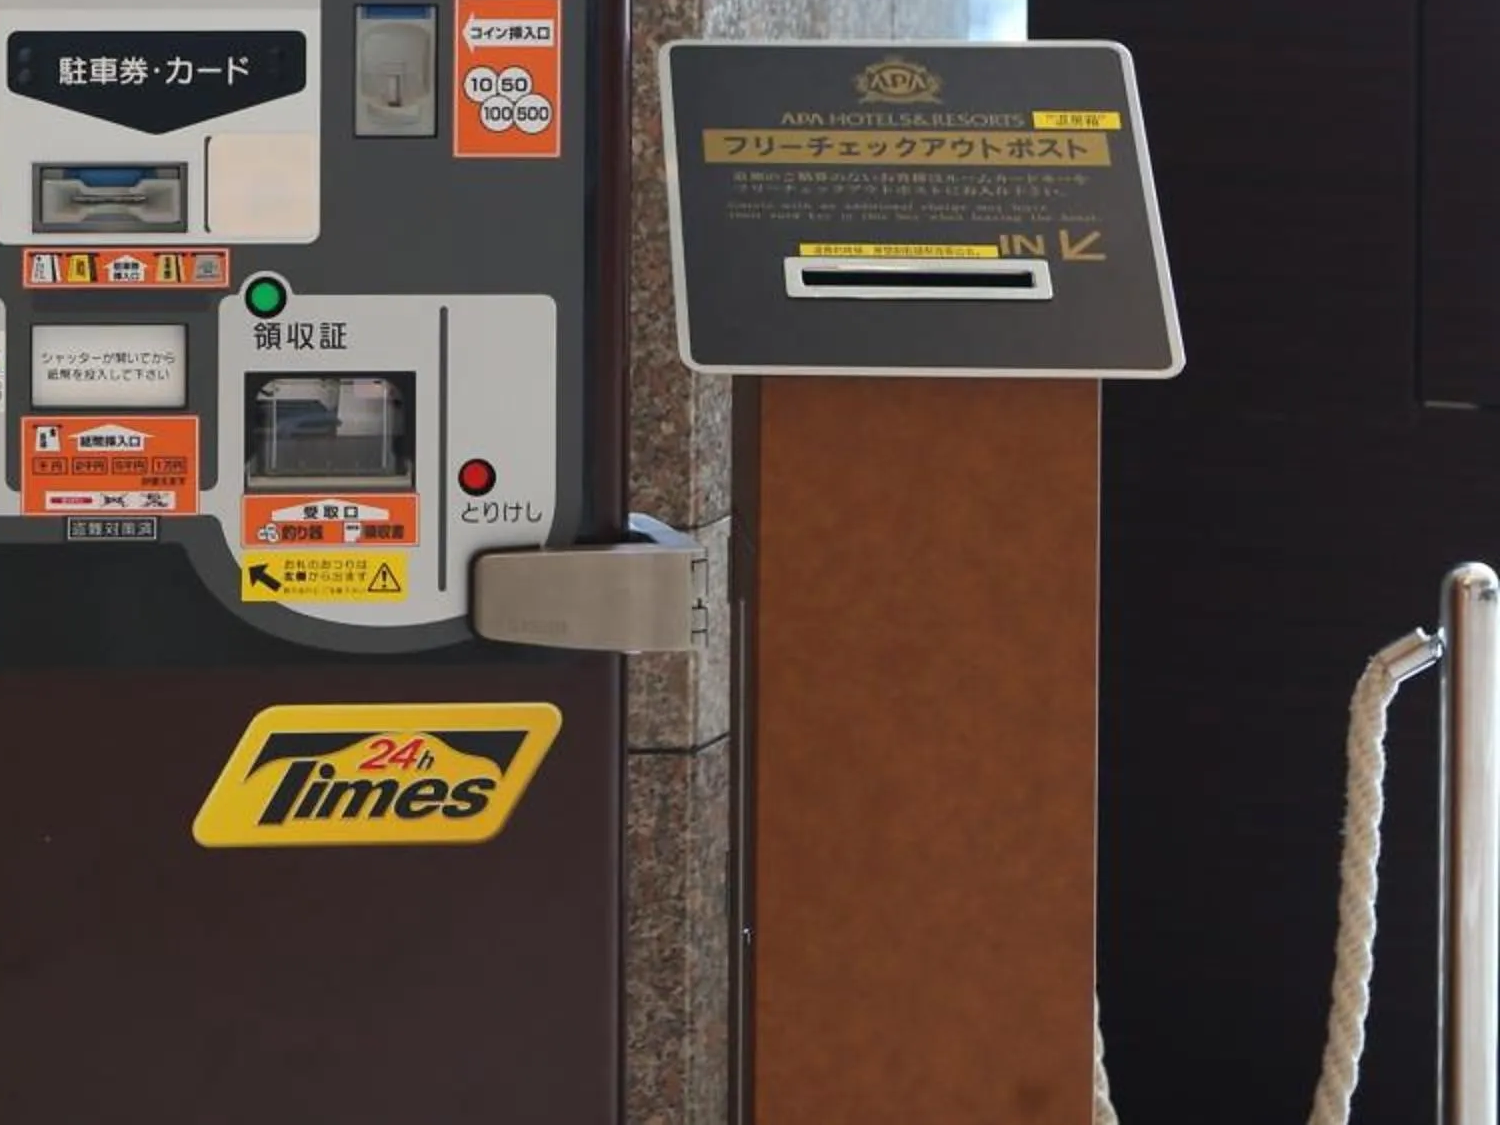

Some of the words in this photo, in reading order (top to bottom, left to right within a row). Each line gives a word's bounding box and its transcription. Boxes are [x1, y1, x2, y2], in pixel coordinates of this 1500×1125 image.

[470, 25, 550, 40] コイン挿入口
[59, 56, 249, 85] 駐車券・カード
[471, 78, 493, 92] 10
[501, 78, 528, 92] 50
[484, 106, 512, 121] 100
[517, 106, 549, 121] 500
[781, 111, 825, 125] APA
[724, 134, 1088, 160] フリーチェックアウトポスト
[1000, 234, 1046, 256] IN
[253, 322, 348, 350] 領収証
[303, 506, 359, 519] 受取口
[460, 501, 543, 524] とりけし
[257, 761, 497, 826] Times
